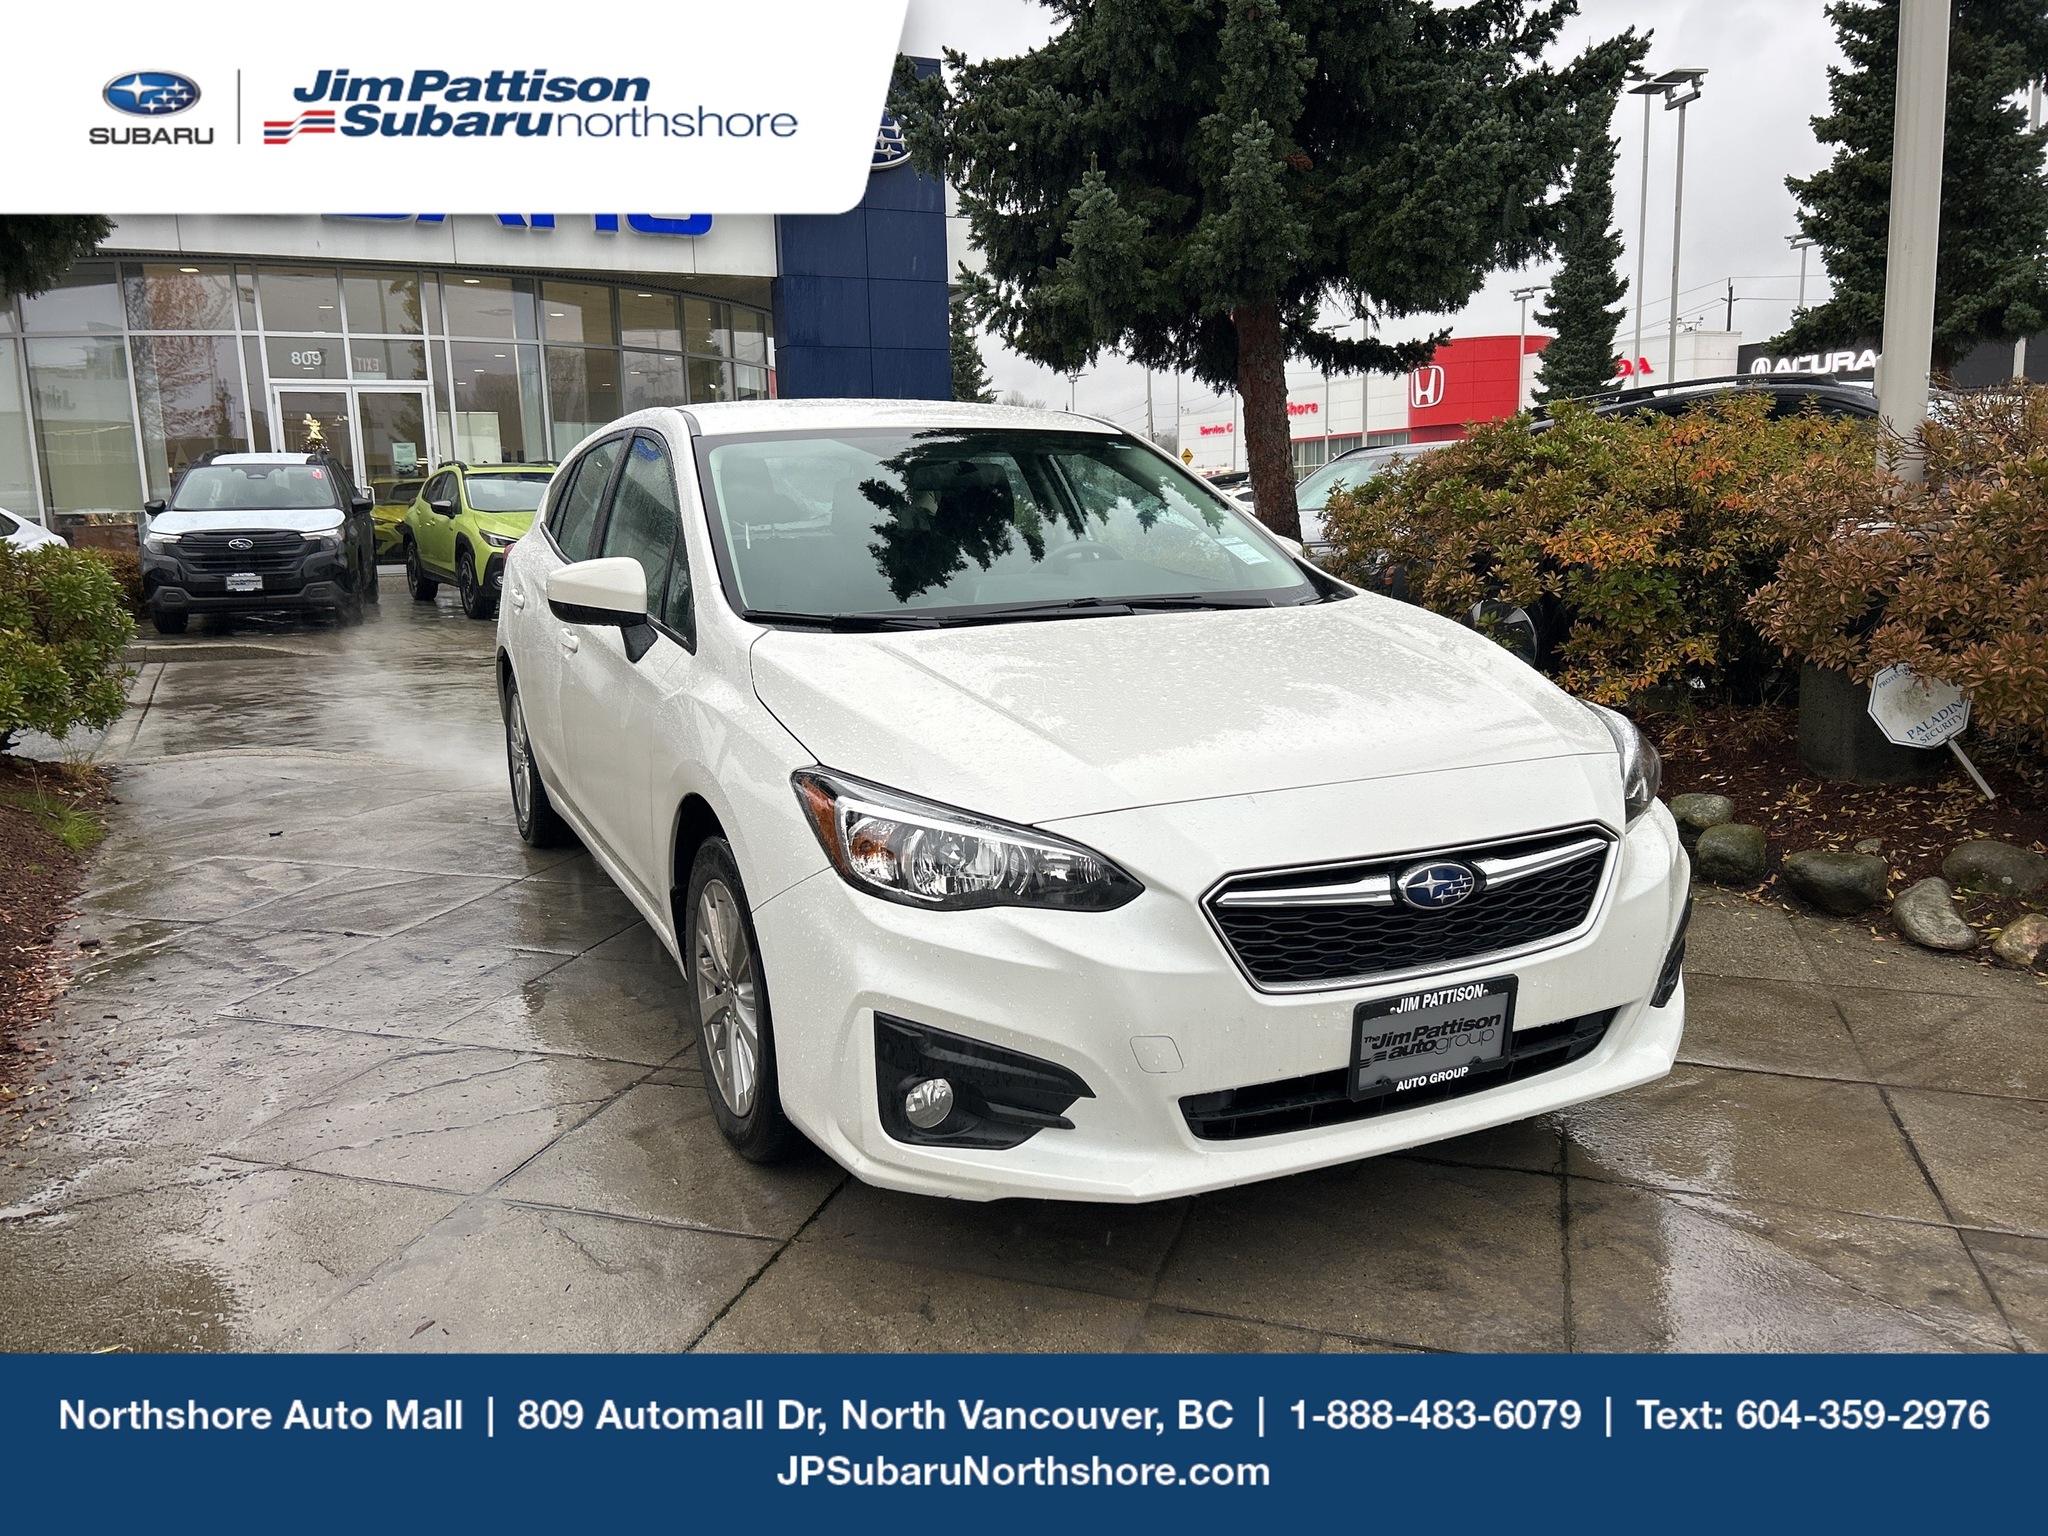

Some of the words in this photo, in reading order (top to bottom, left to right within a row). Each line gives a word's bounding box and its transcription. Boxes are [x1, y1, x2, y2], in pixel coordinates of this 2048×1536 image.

[291, 351, 322, 366] 809
[1774, 349, 1878, 375] ACURA
[1906, 699, 1963, 740] PALADIN
[1919, 713, 1963, 743] SECURITY
[1396, 995, 1420, 1014] JIM
[1422, 983, 1485, 1009] PATTISON
[1396, 1075, 1427, 1092] AUTO
[1429, 1066, 1469, 1084] GROUP
